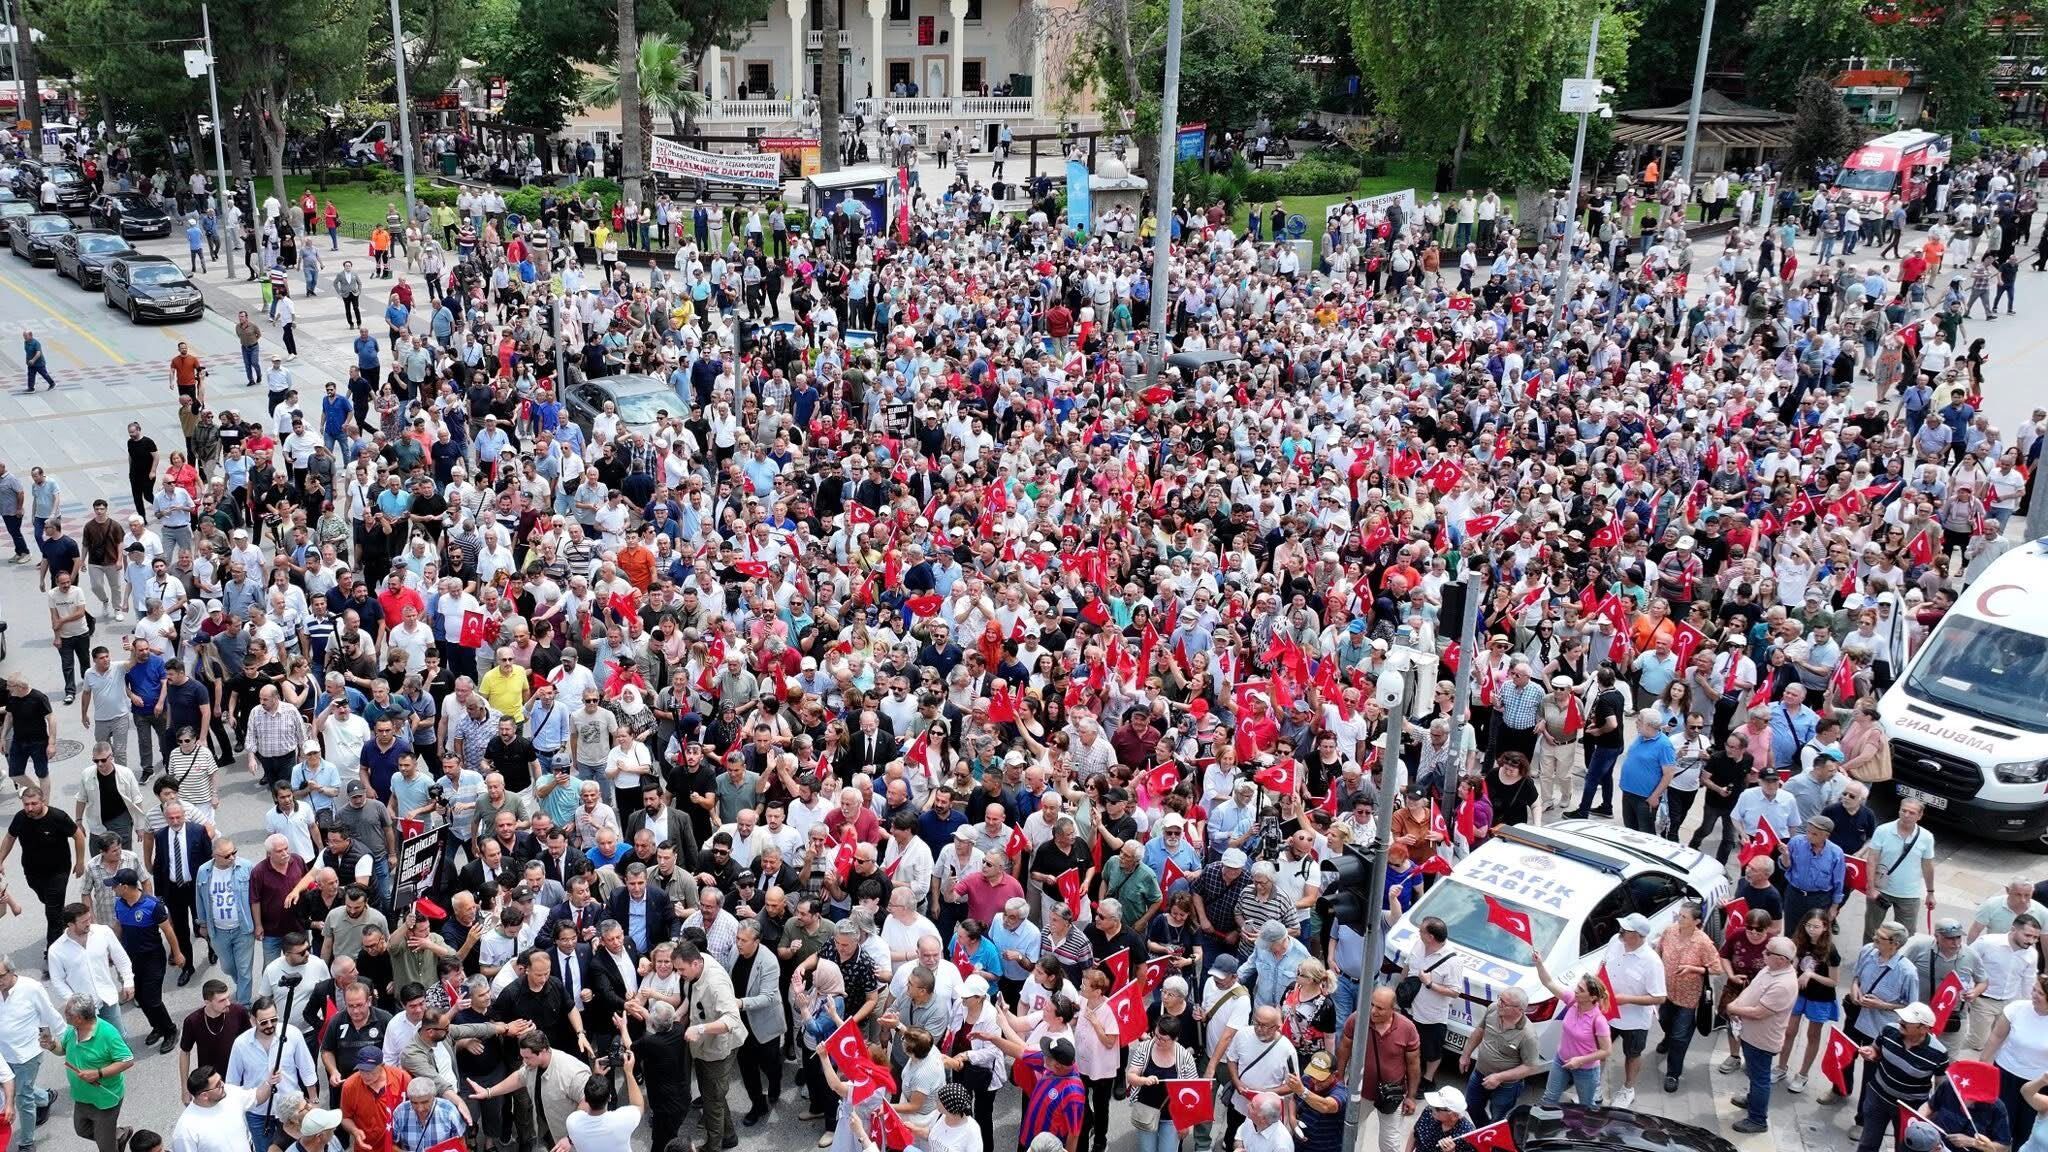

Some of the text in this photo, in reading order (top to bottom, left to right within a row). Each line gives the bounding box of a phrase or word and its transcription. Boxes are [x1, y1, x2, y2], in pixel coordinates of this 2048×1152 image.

[656, 156, 675, 166] TÜM
[676, 160, 720, 174] HALKIMIZ
[721, 168, 775, 179] DAVETLİDİR
[213, 881, 233, 894] JUS
[1478, 860, 1575, 897] TRAFİK
[1464, 869, 1562, 909] ZABITA
[220, 908, 232, 920] IT
[340, 1024, 350, 1038] 7
